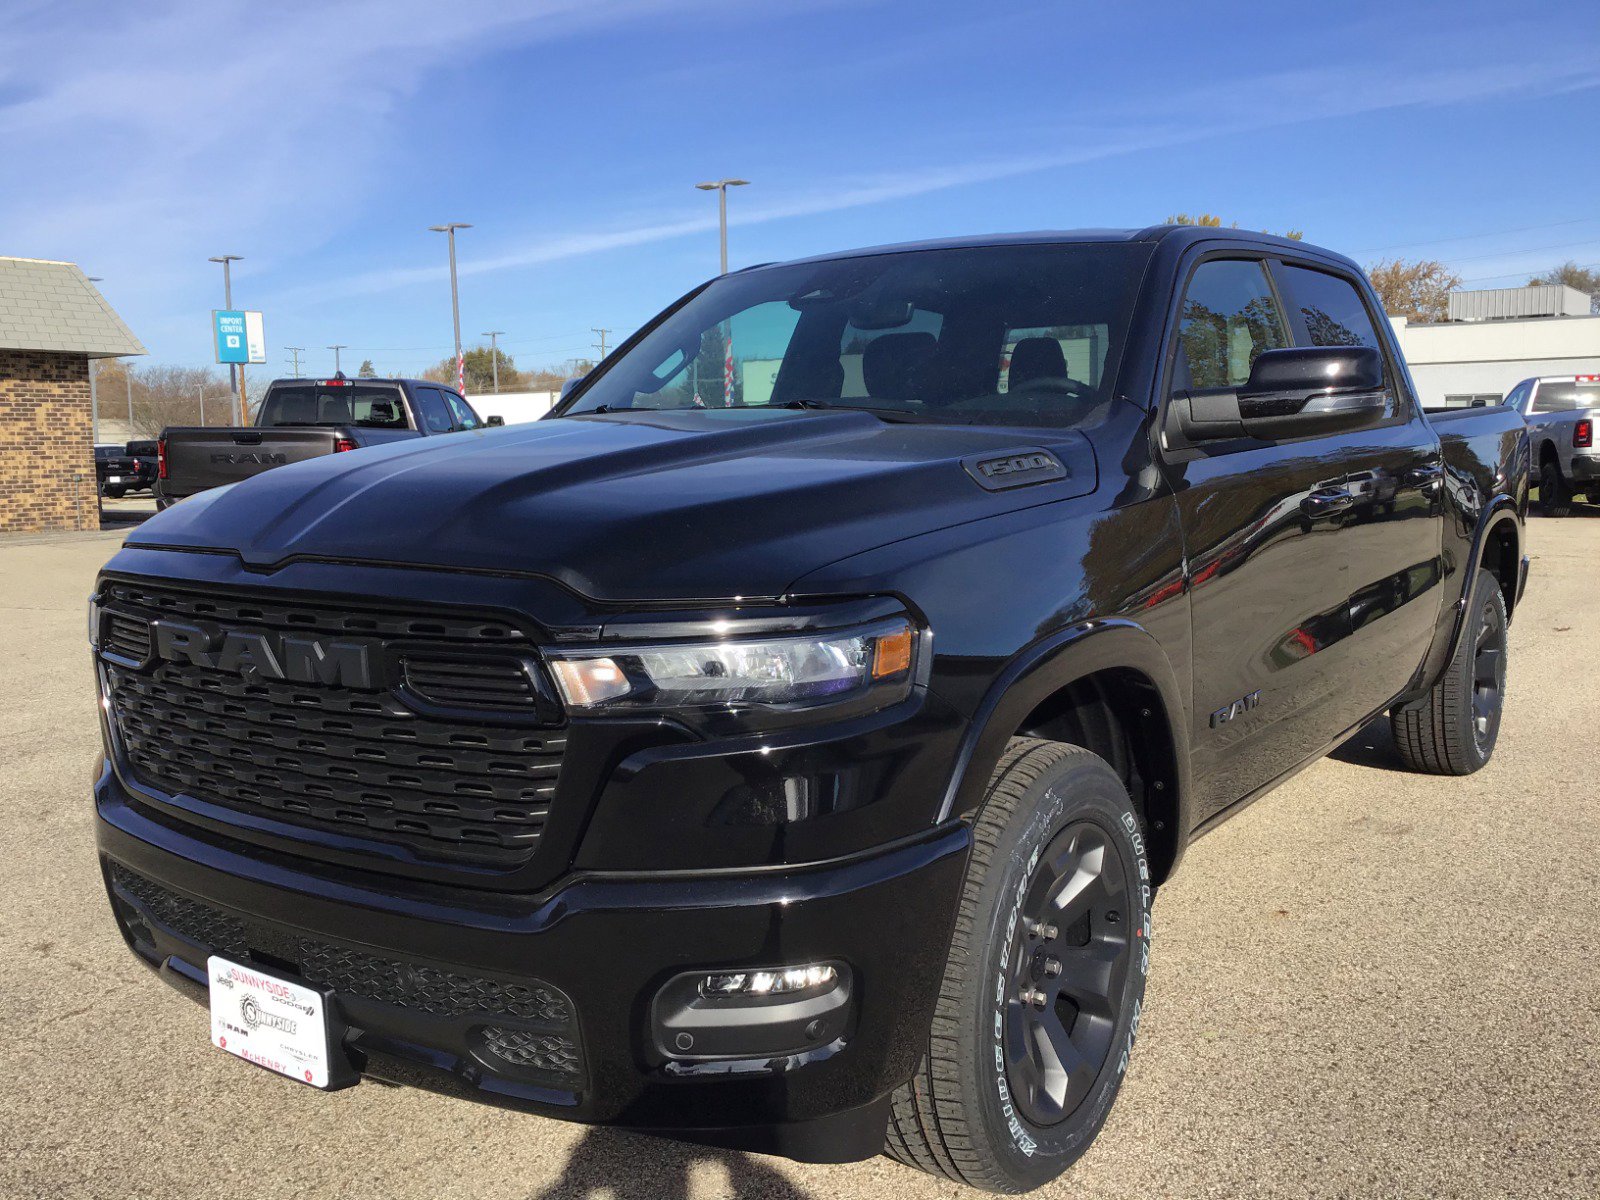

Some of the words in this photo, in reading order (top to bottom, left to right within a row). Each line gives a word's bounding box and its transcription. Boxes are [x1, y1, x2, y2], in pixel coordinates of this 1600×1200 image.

[219, 317, 242, 325] IMPORT
[220, 325, 243, 333] CENTER
[210, 453, 286, 464] RAM
[981, 455, 1045, 477] 1500
[155, 618, 376, 689] RAM
[1209, 689, 1262, 729] RAM
[1120, 811, 1151, 976] DUELER
[216, 973, 234, 990] Jeep
[231, 968, 290, 999] SUNNYSIDE
[271, 995, 310, 1013] DODGE
[995, 844, 1039, 1157] BRIDGESTONE
[227, 1022, 248, 1037] RAM
[241, 1048, 287, 1073] McHENRY
[280, 1043, 319, 1061] CHRYSLER
